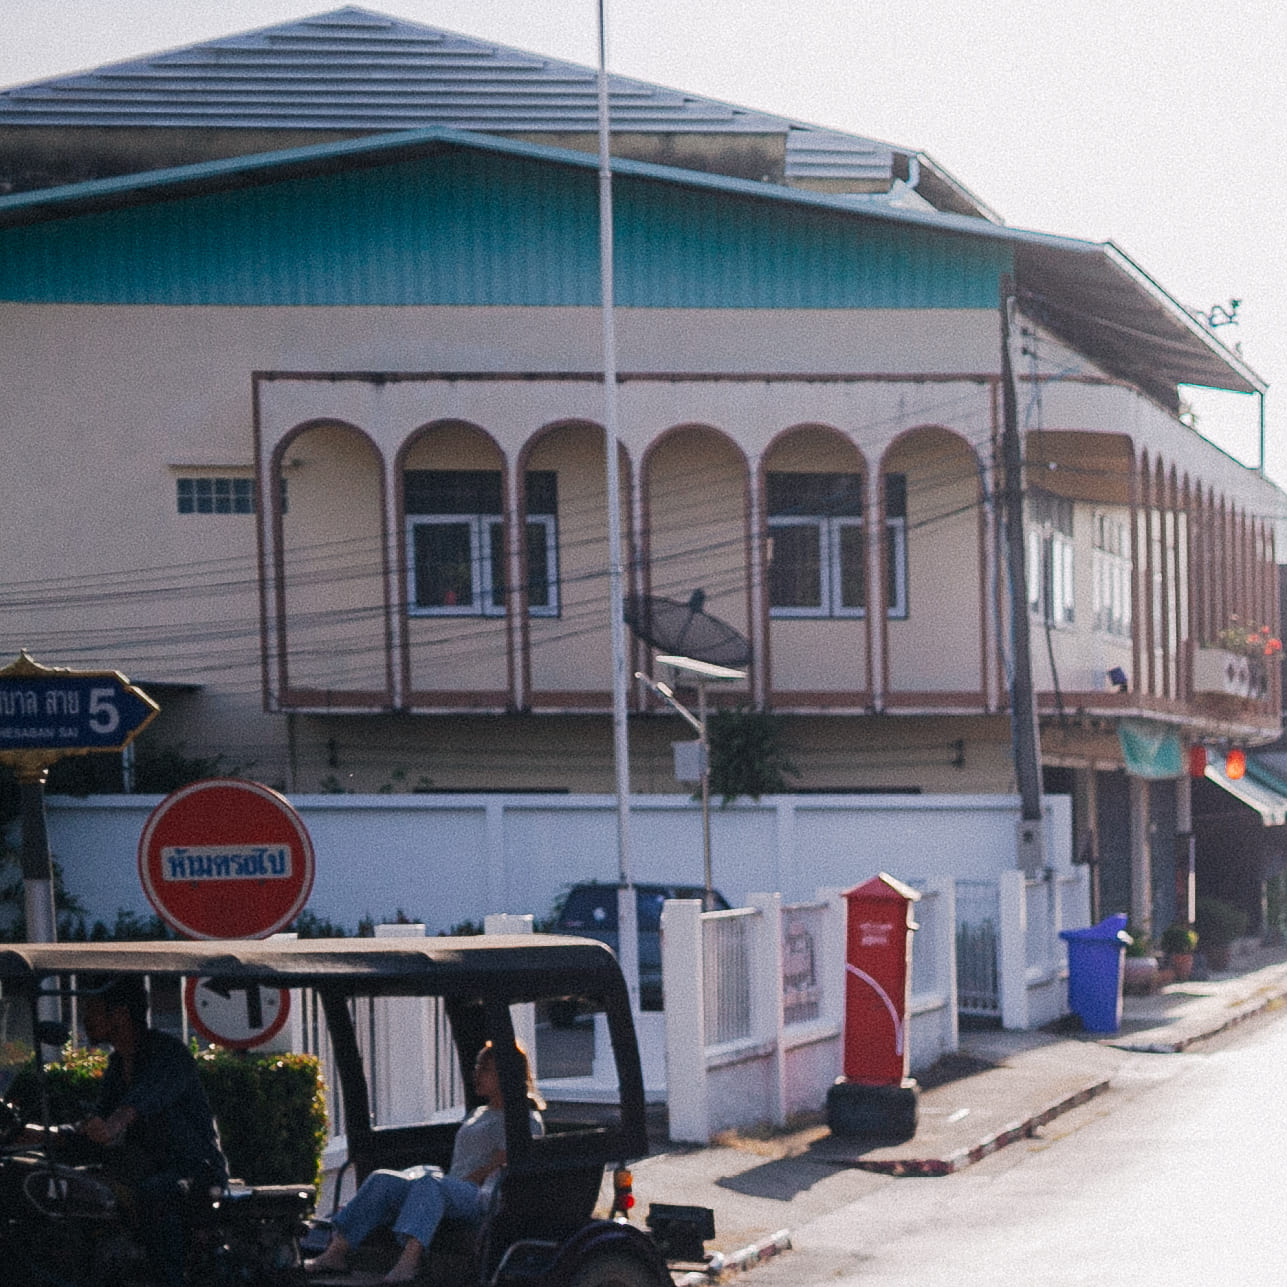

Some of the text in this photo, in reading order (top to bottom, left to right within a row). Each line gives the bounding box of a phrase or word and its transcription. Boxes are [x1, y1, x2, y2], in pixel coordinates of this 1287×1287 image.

[46, 689, 79, 714] สาย
[88, 687, 120, 733] 5
[167, 847, 287, 878] ห้ามตรงไป
